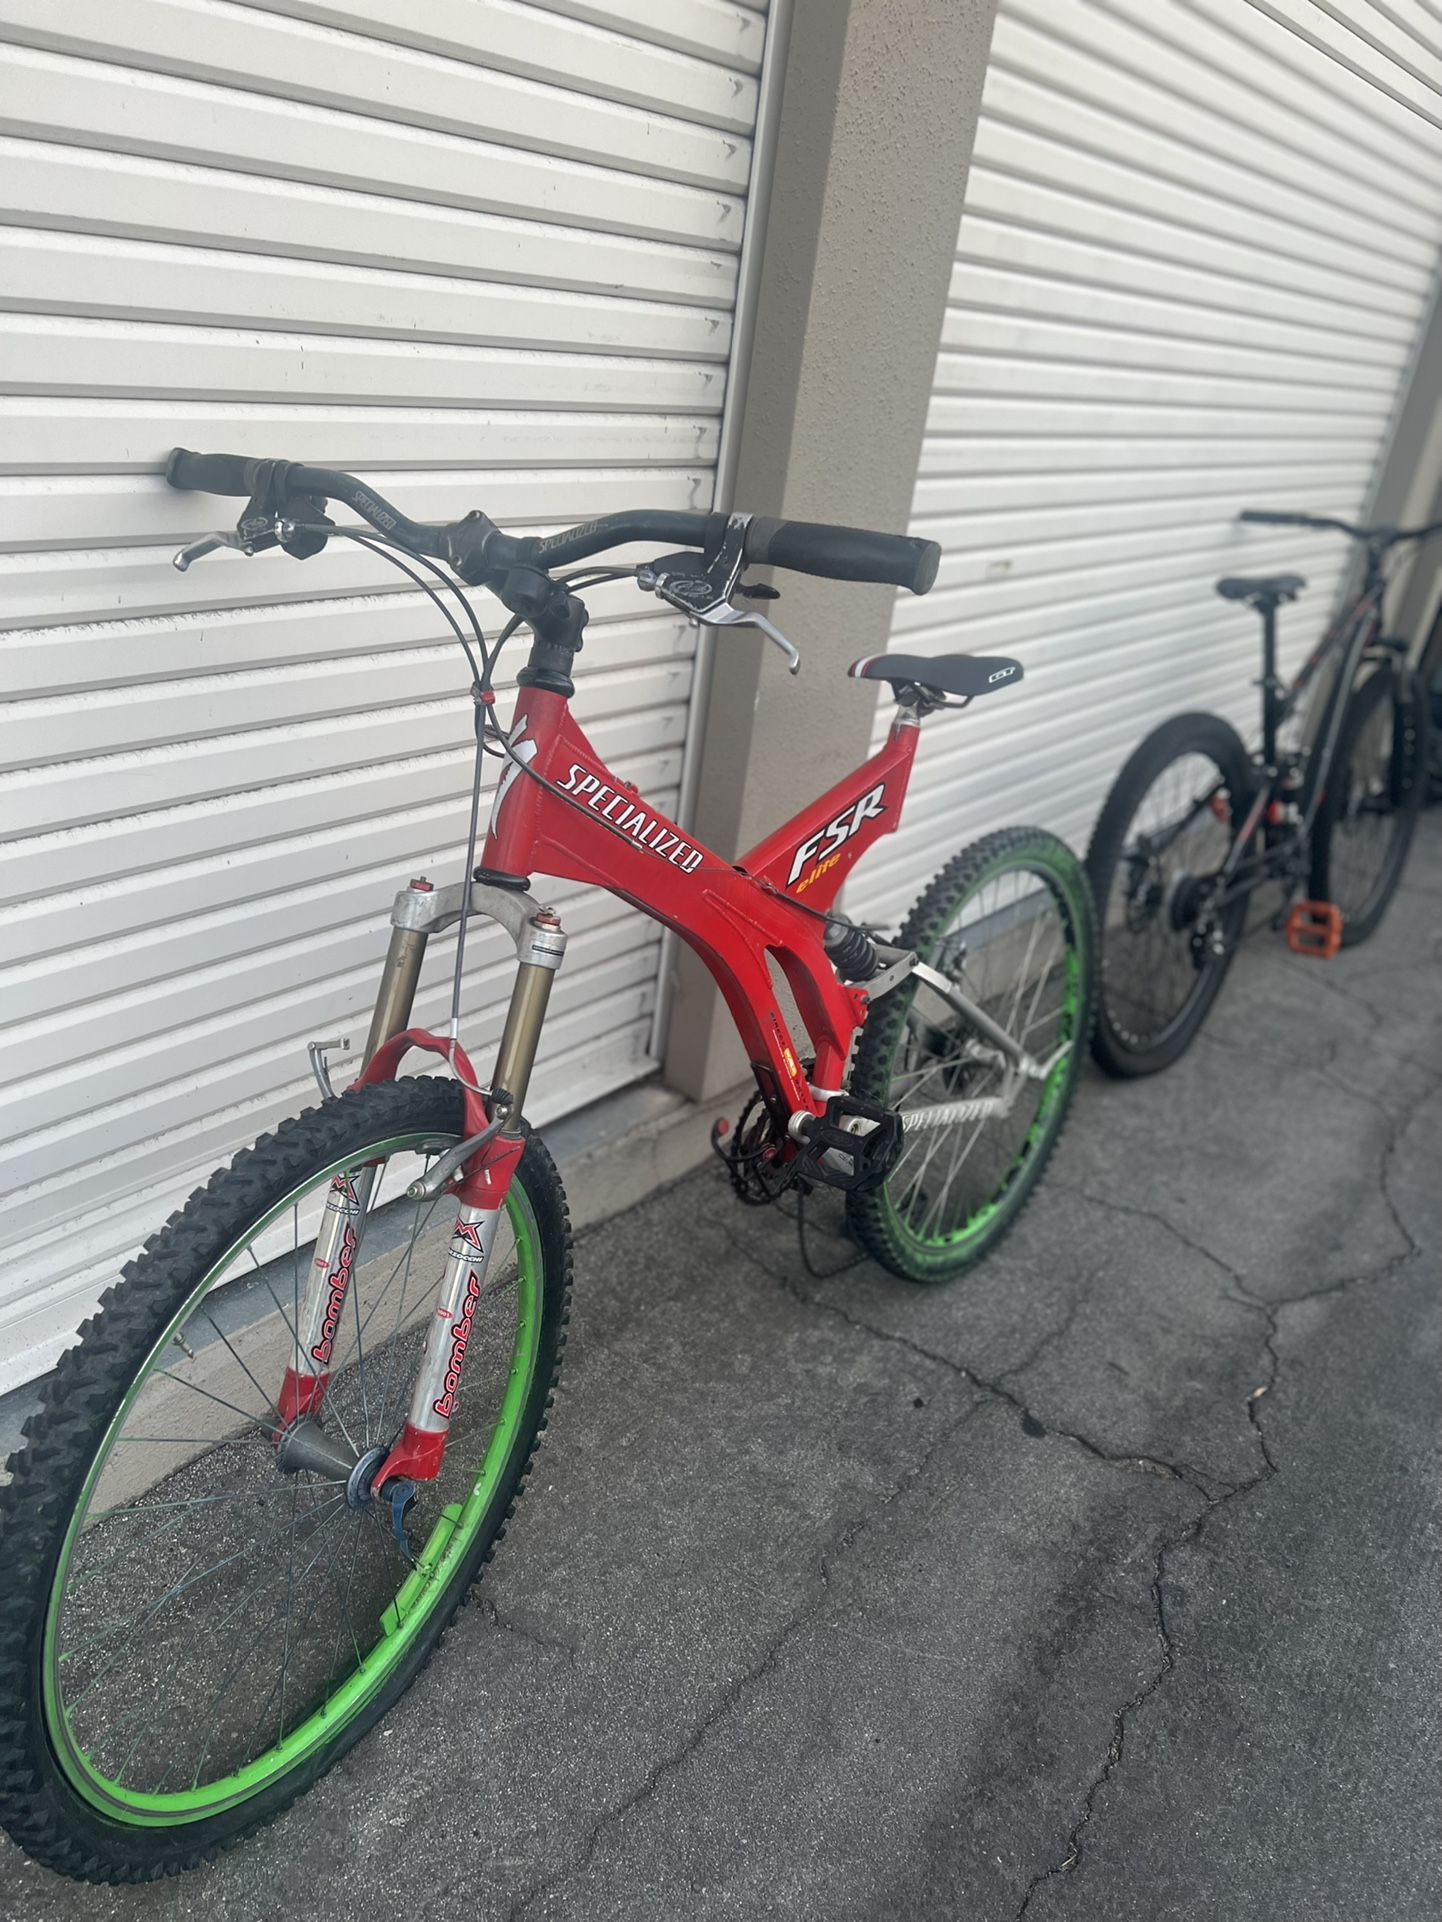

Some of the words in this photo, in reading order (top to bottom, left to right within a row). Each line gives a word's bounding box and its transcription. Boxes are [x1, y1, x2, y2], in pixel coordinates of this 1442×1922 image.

[556, 763, 705, 875] SPECIALIZED
[786, 783, 887, 888] FSR
[796, 853, 841, 894] elite
[311, 1221, 358, 1364] bomber
[433, 1269, 480, 1419] bomber
